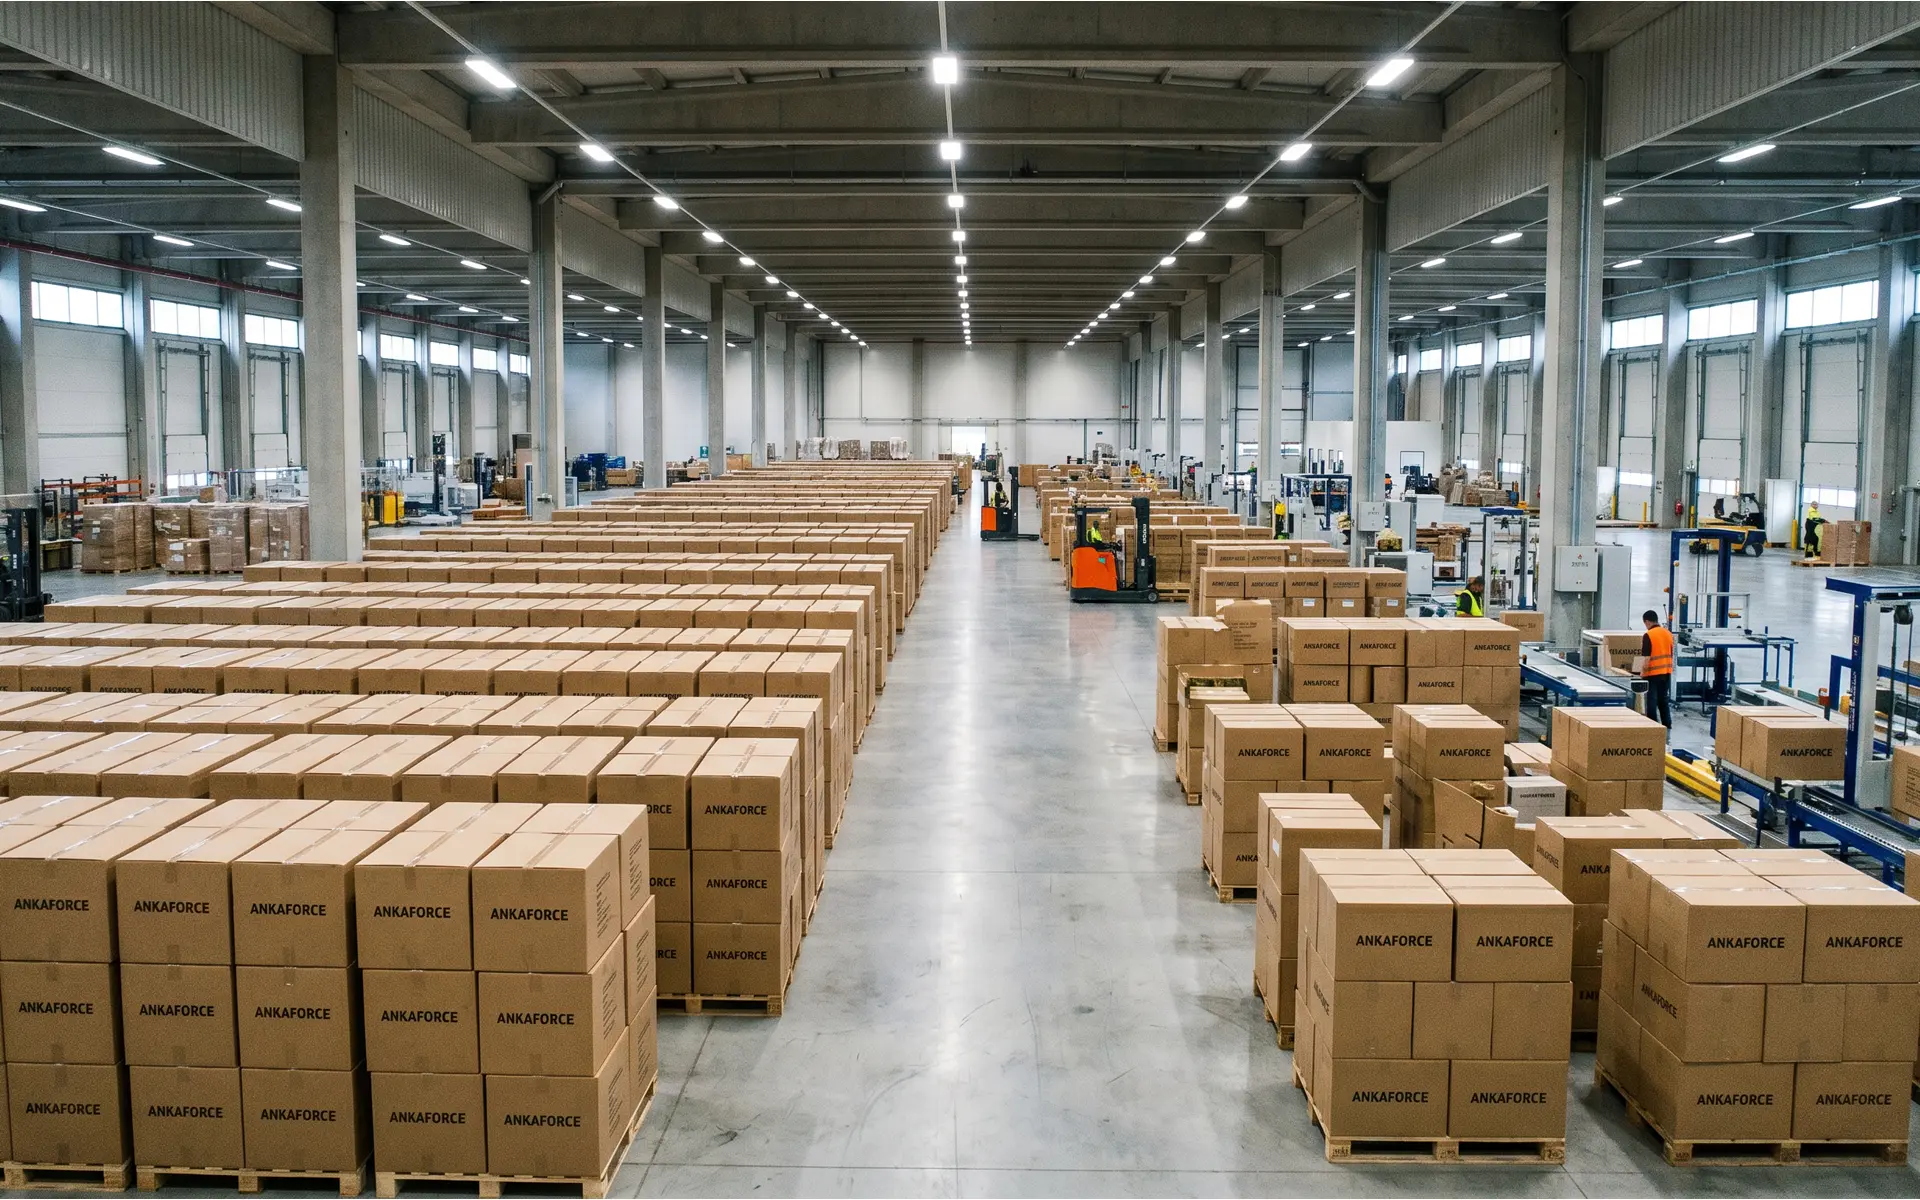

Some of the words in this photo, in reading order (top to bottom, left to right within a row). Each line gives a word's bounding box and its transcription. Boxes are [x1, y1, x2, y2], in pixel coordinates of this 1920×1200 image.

[1237, 748, 1290, 757] ANKAFORCE
[1319, 748, 1372, 757] ANKAFORCE
[1439, 748, 1491, 757] ANKAFORCE
[1601, 747, 1653, 757] ANKAFORCE
[1780, 747, 1833, 757] ANKAFORCE
[704, 804, 767, 816] ANKAFORCE
[706, 878, 768, 889] ANKAFORCE
[13, 898, 90, 911] ANKAFORCE
[133, 900, 210, 913] ANKAFORCE
[249, 903, 327, 916] ANKAFORCE
[373, 905, 451, 918] ANKAFORCE
[490, 907, 569, 920] ANKAFORCE
[1355, 934, 1433, 946] ANKAFORCE
[1476, 935, 1554, 947] ANKAFORCE
[1707, 937, 1786, 949] ANKAFORCE
[1825, 936, 1904, 948] ANKAFORCE
[706, 950, 767, 961] ANKAFORCE
[18, 1001, 94, 1014] ANKAFORCE
[139, 1004, 215, 1016] ANKAFORCE
[254, 1006, 331, 1019] ANKAFORCE
[380, 1010, 458, 1022] ANKAFORCE
[496, 1012, 575, 1025] ANKAFORCE
[1351, 1091, 1429, 1103] ANKAFORCE
[1470, 1092, 1547, 1104] ANKAFORCE
[1696, 1093, 1774, 1105] ANKAFORCE
[1815, 1093, 1893, 1105] ANKAFORCE
[25, 1102, 101, 1115] ANKAFORCE
[147, 1105, 224, 1118] ANKAFORCE
[260, 1108, 337, 1121] ANKAFORCE
[389, 1111, 466, 1123] ANKAFORCE
[503, 1114, 581, 1127] ANKAFORCE
